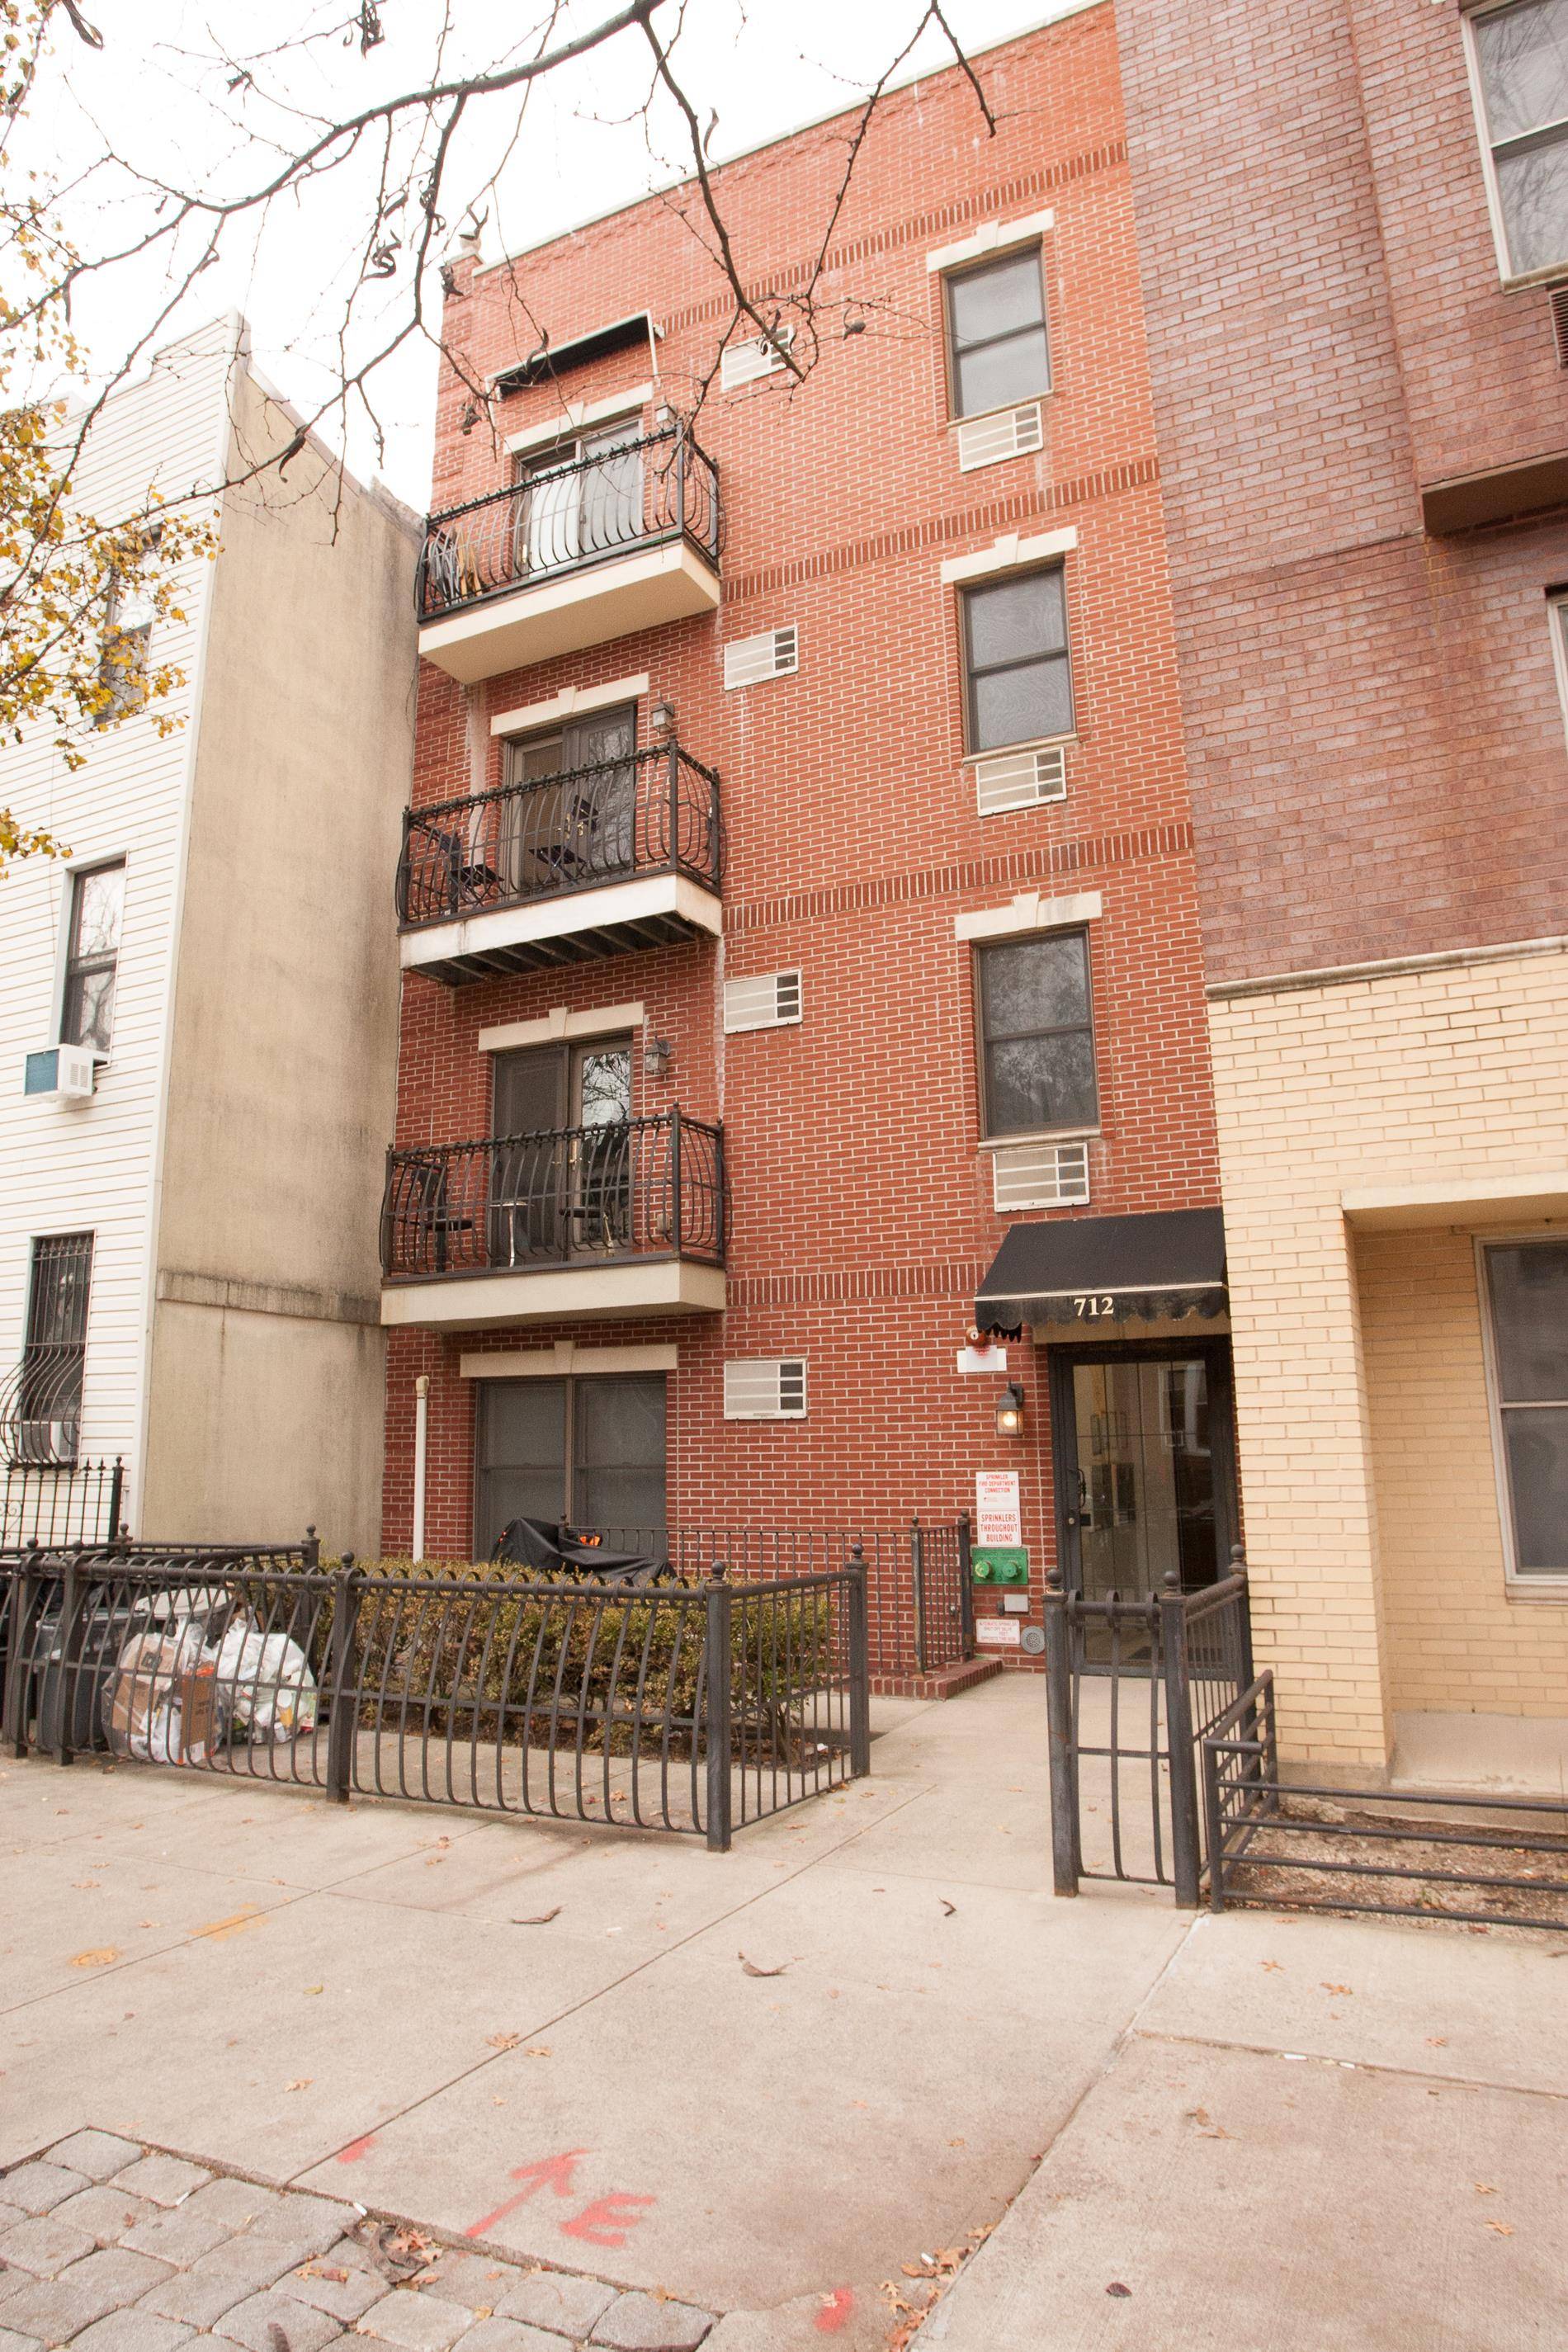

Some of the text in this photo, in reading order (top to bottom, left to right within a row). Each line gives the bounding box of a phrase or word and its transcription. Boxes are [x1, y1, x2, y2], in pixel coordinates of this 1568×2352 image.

[1074, 1296, 1114, 1316] 712
[981, 1514, 1017, 1522] SPRINKLERS
[980, 1523, 1018, 1533] THROUGHOUT
[986, 1533, 1013, 1542] BUILDING
[560, 2192, 657, 2246] E
